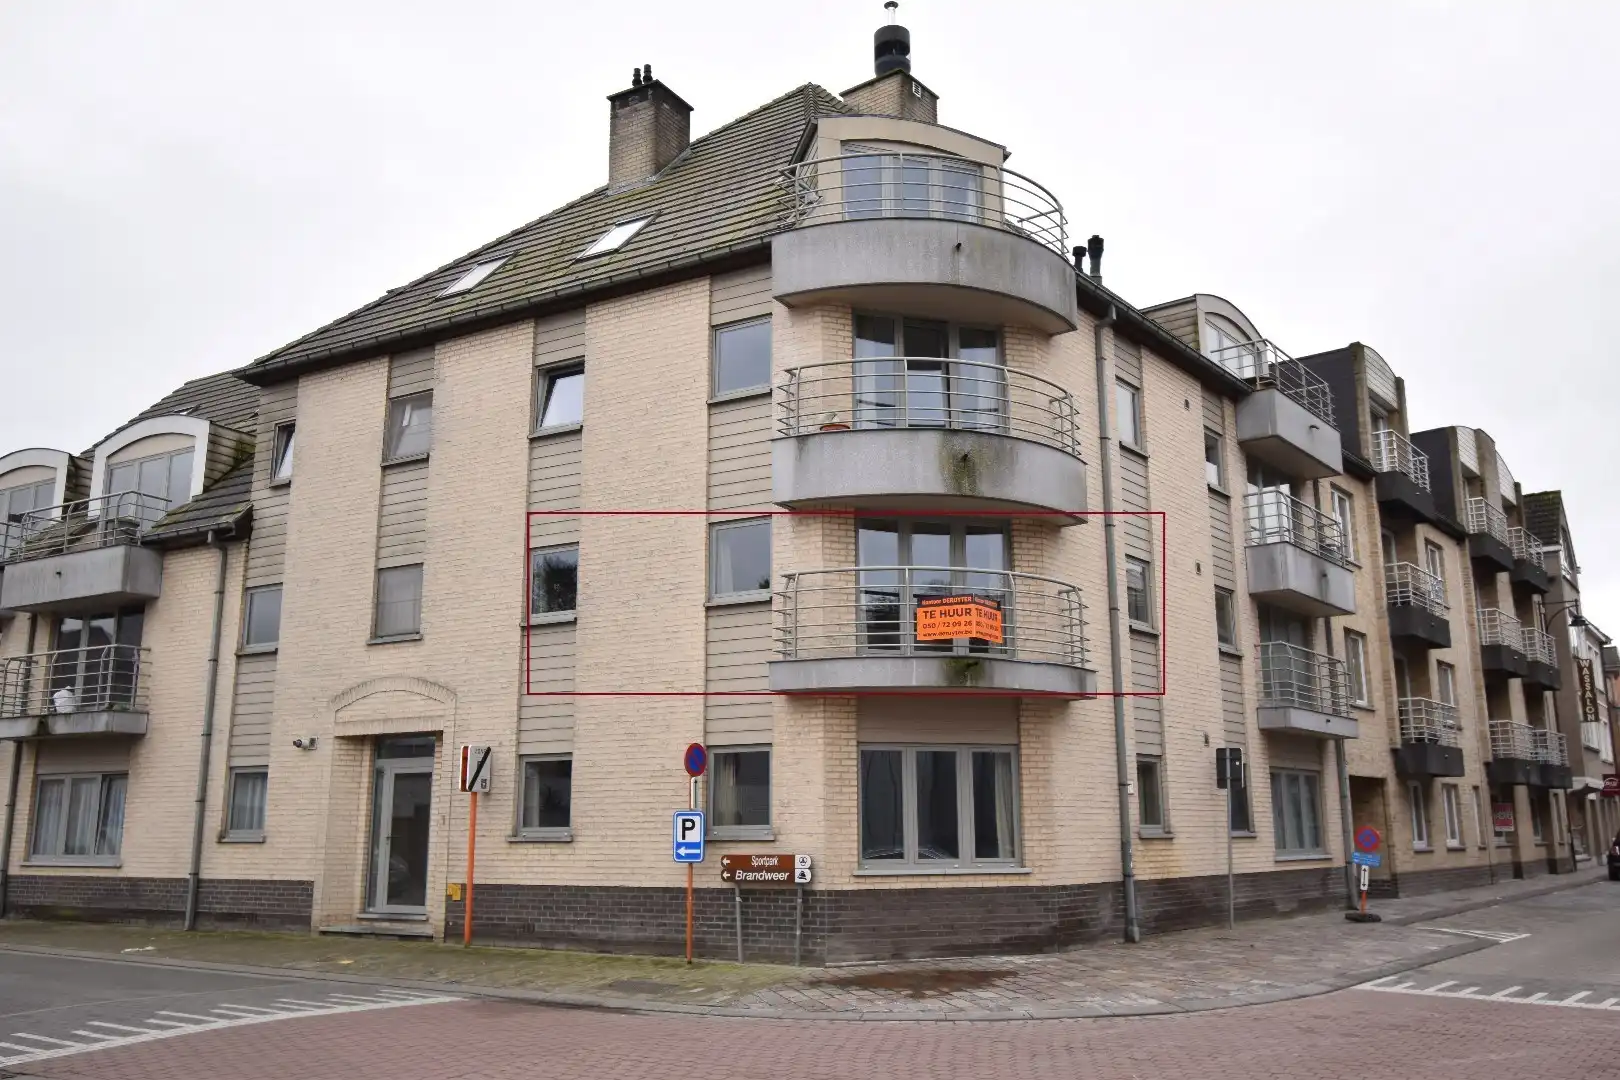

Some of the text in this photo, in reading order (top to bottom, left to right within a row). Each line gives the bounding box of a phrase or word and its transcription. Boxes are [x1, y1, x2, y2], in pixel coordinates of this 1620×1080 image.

[923, 608, 972, 619] TE HUUR
[975, 608, 982, 617] TE
[1579, 659, 1595, 721] WASSALON
[681, 818, 696, 841] P
[751, 855, 779, 867] Sportpark
[735, 870, 789, 881] Brandweer
